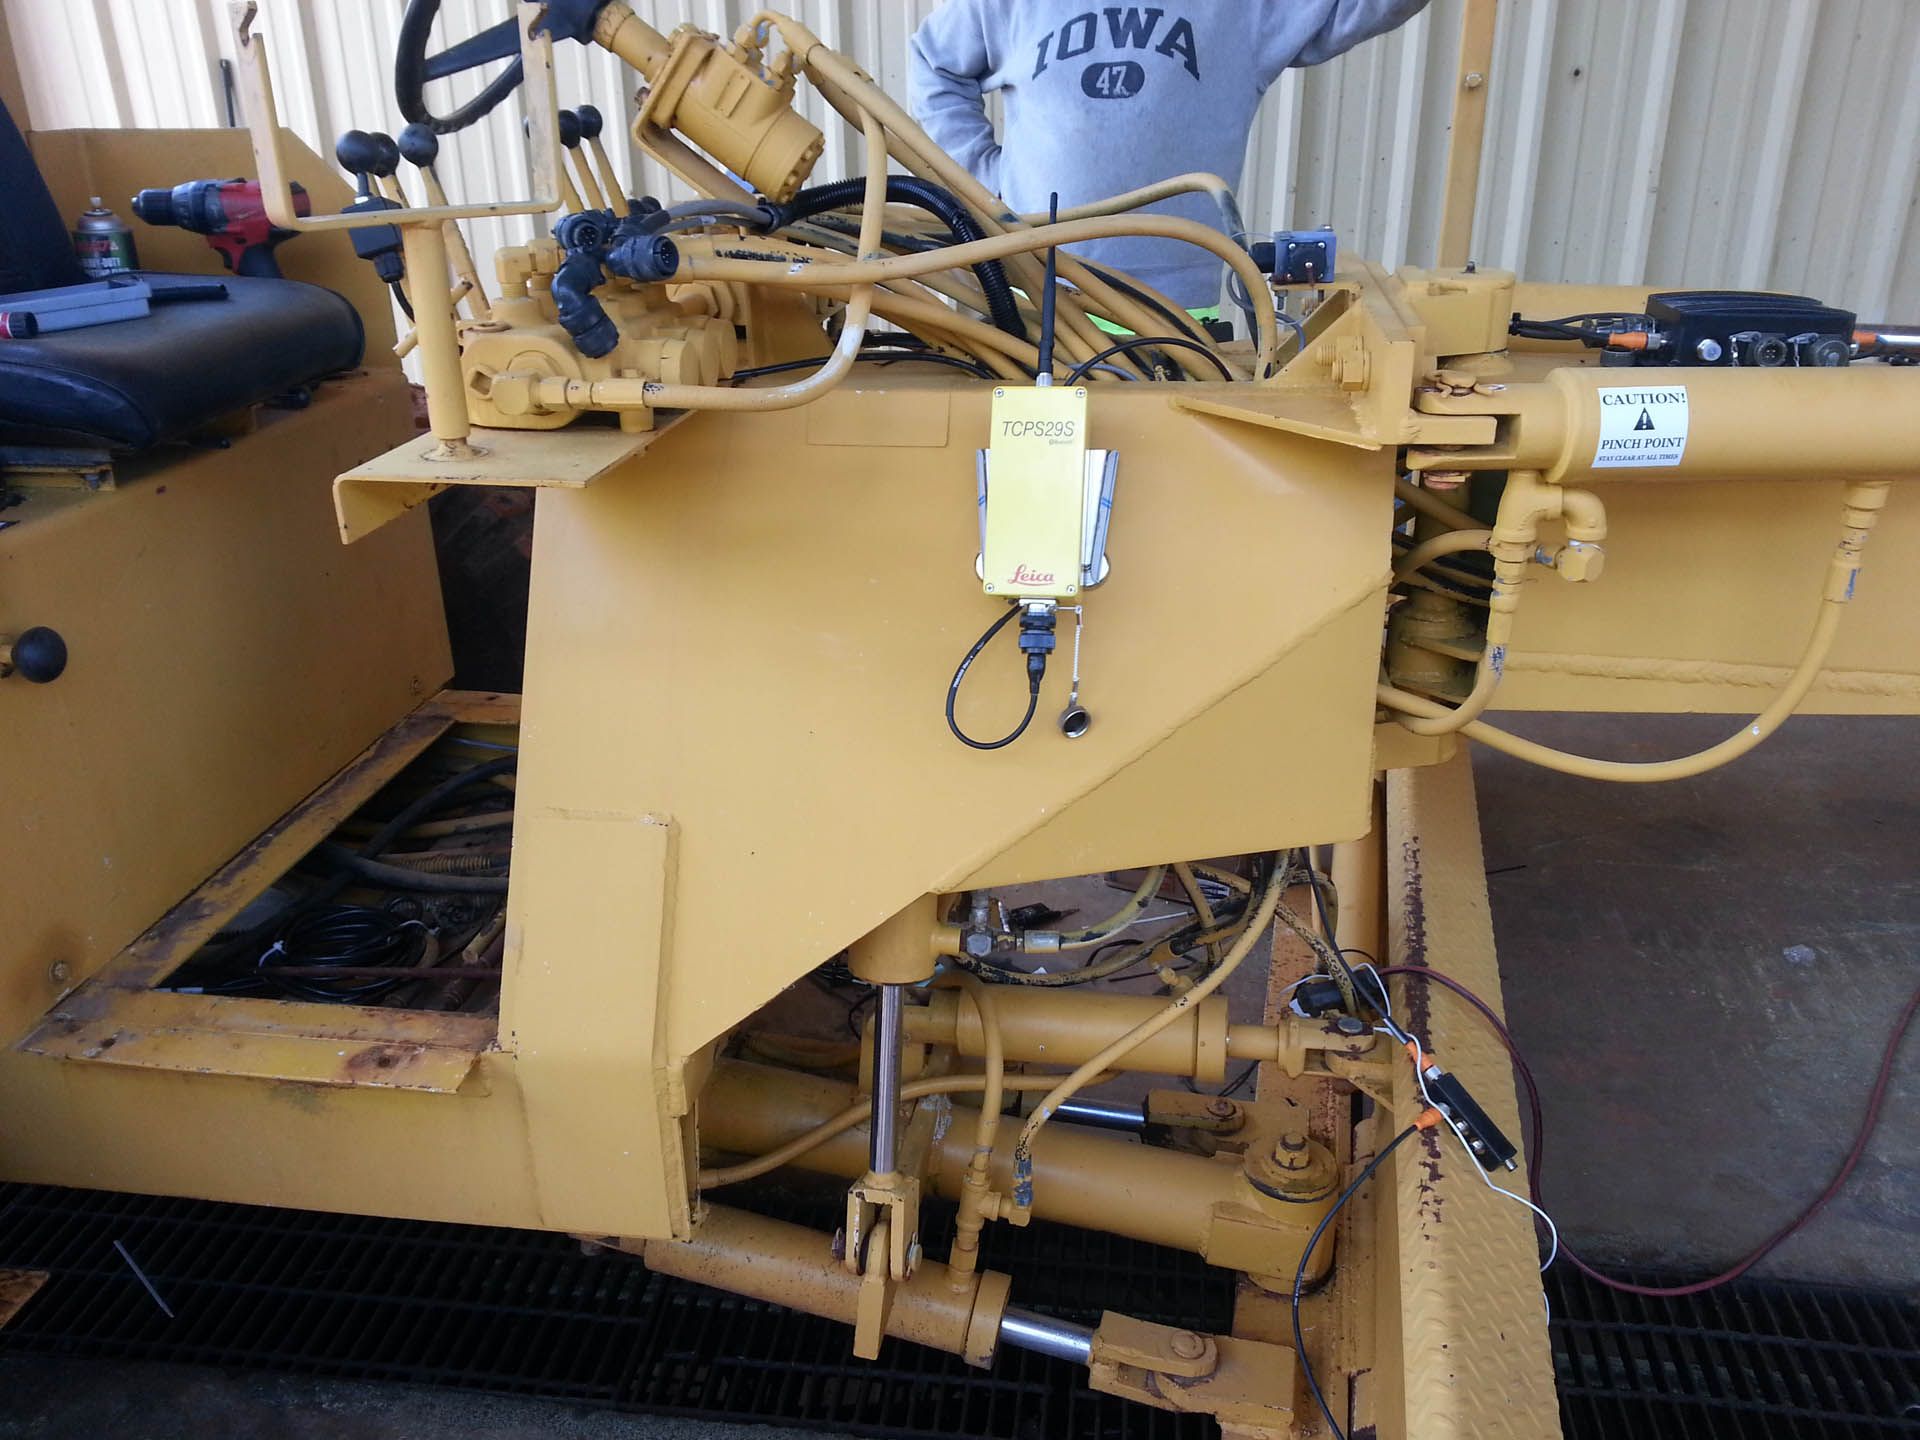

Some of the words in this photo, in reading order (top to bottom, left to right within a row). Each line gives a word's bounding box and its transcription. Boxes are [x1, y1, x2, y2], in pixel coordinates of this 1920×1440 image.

[1032, 7, 1200, 81] IOWA
[1095, 65, 1129, 96] 47
[1602, 392, 1687, 406] CAUTION!
[1002, 420, 1076, 437] TCPS29S
[1601, 438, 1642, 450] PINCH
[1644, 437, 1685, 449] POINT
[1008, 563, 1055, 586] Leica
